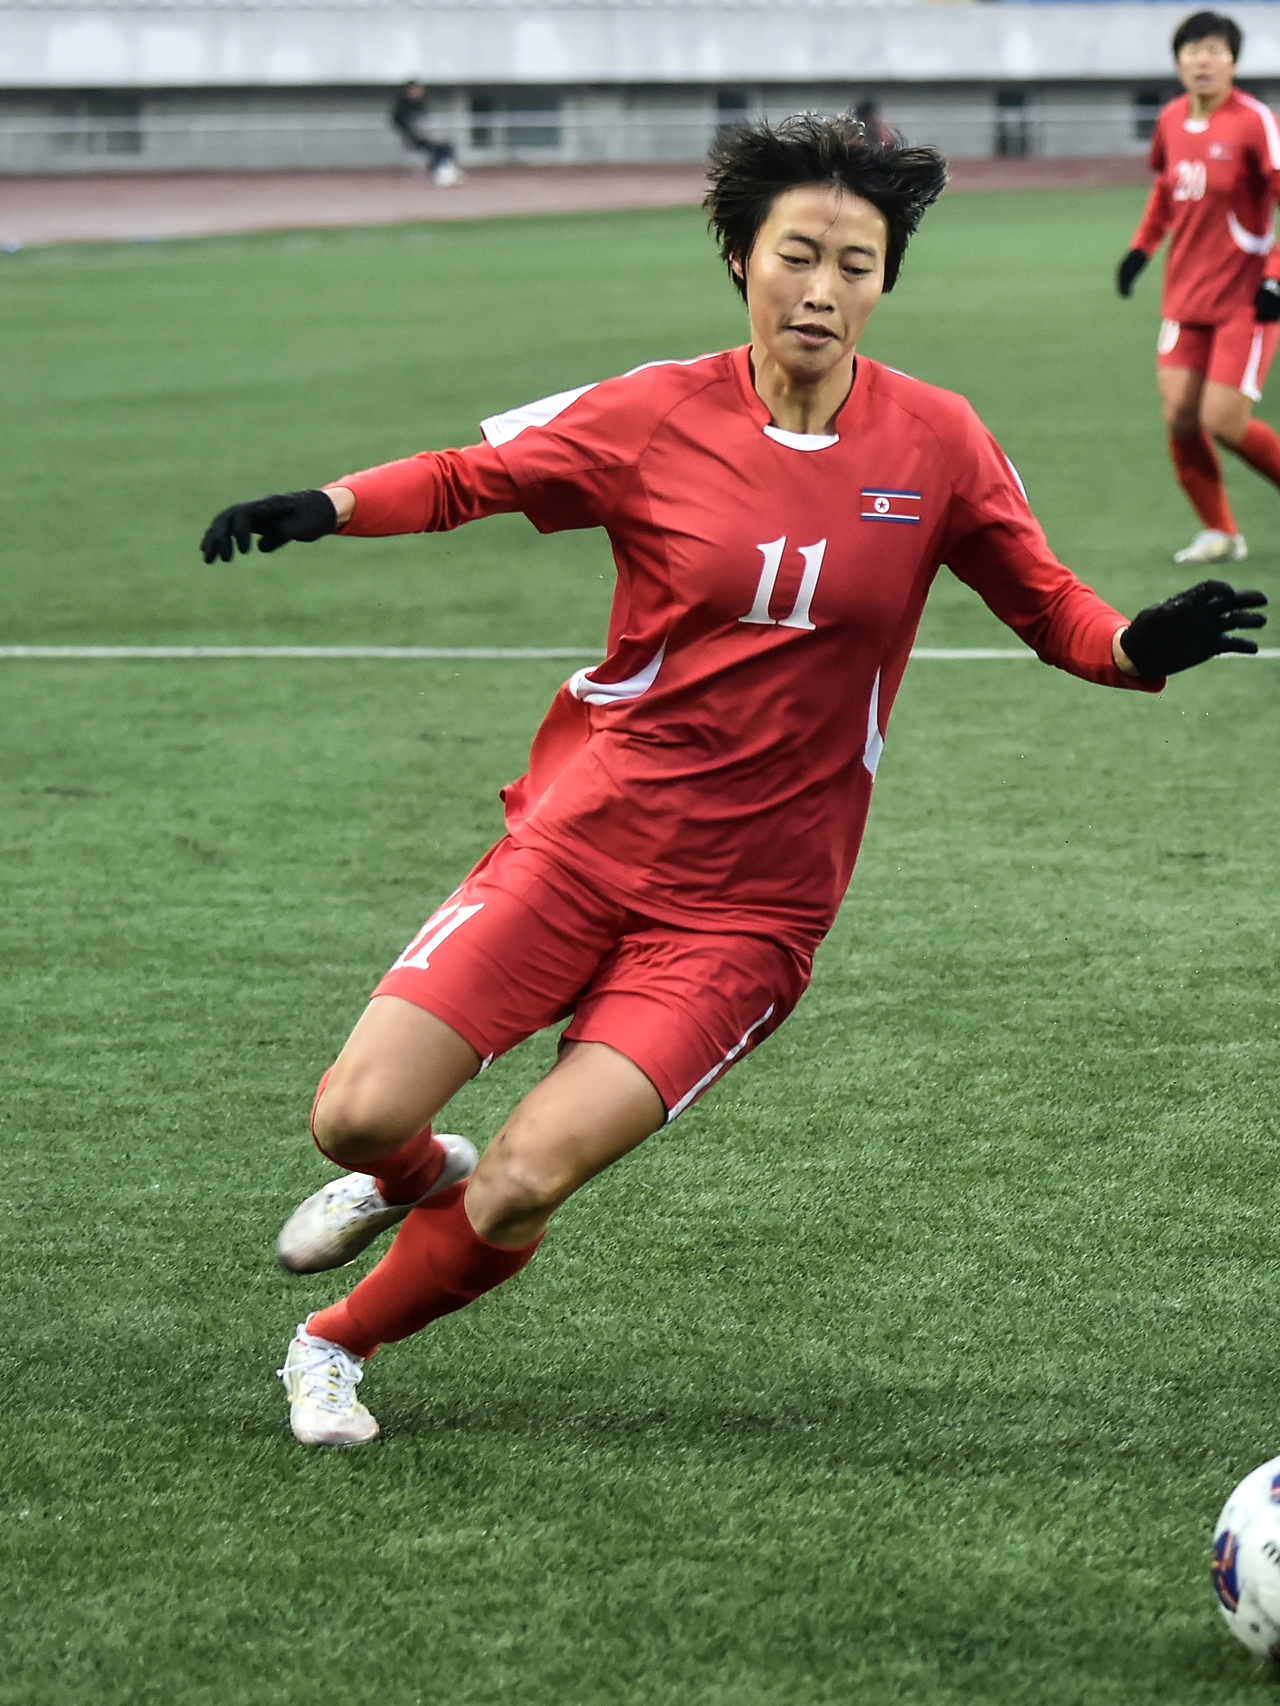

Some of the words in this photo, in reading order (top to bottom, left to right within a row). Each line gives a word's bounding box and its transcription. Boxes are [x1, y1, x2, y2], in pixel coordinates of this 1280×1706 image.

[1173, 159, 1207, 202] 20
[738, 535, 827, 631] 11
[389, 901, 485, 971] 11
